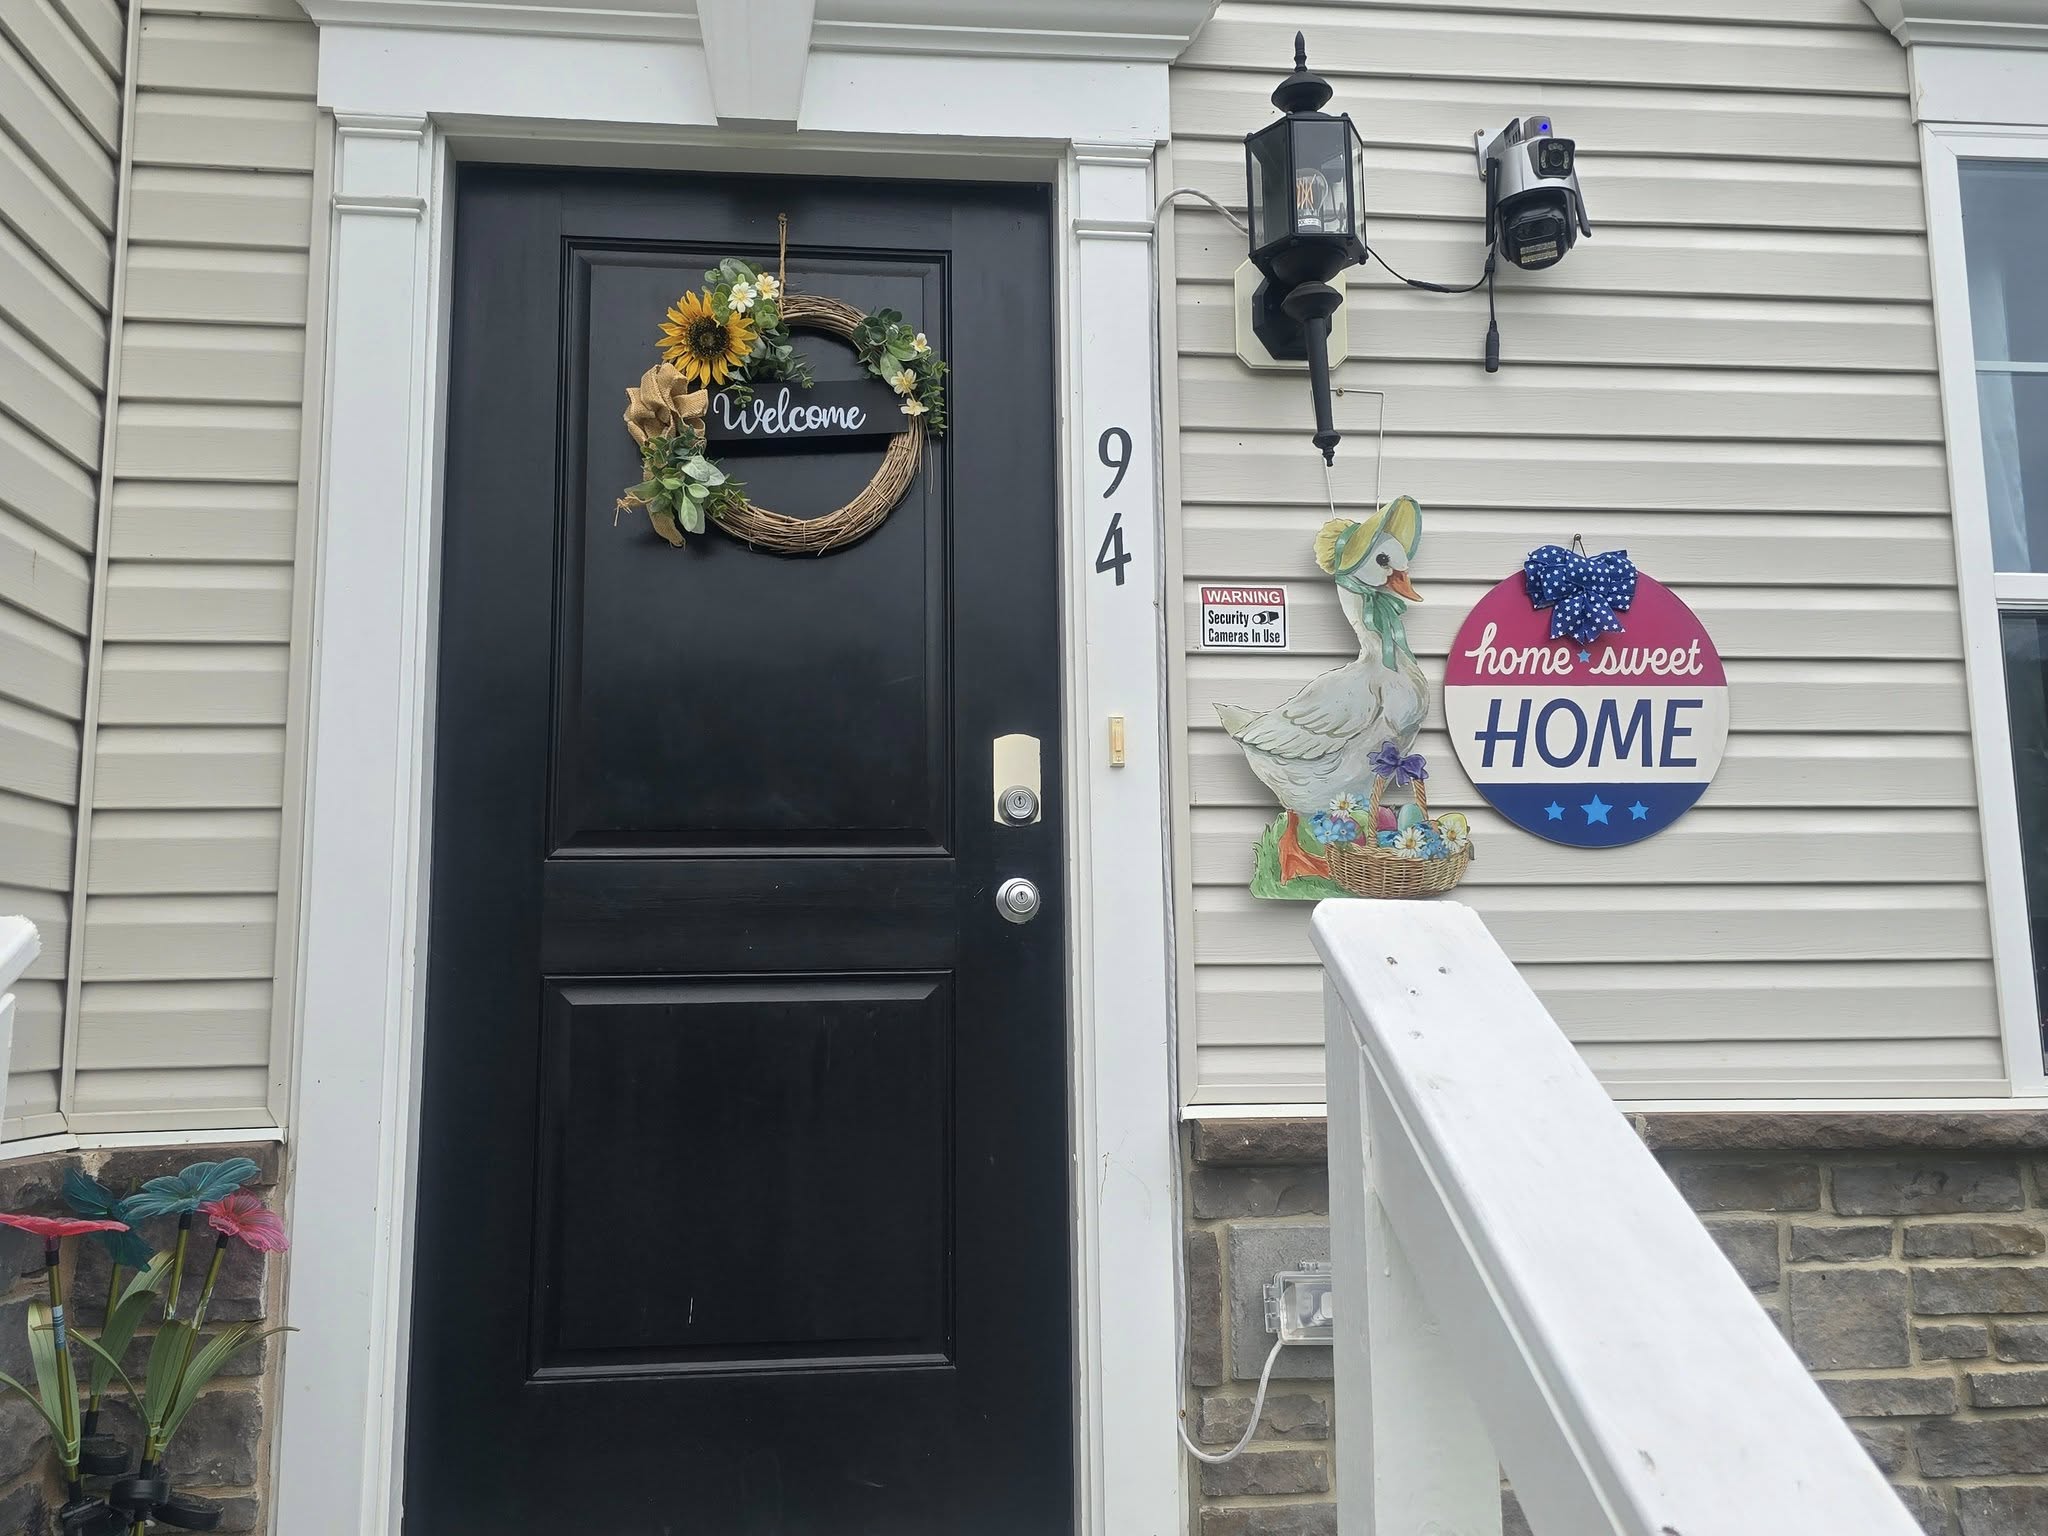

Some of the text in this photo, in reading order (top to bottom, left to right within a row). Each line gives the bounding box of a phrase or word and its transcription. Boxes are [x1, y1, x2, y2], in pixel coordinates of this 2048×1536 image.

[712, 386, 867, 435] Welcome
[1206, 590, 1280, 604] WARNING
[1208, 610, 1249, 627] Security
[1208, 628, 1281, 643] Cameras In Use
[1465, 622, 1704, 676] home sweet
[1474, 698, 1704, 769] HOME
